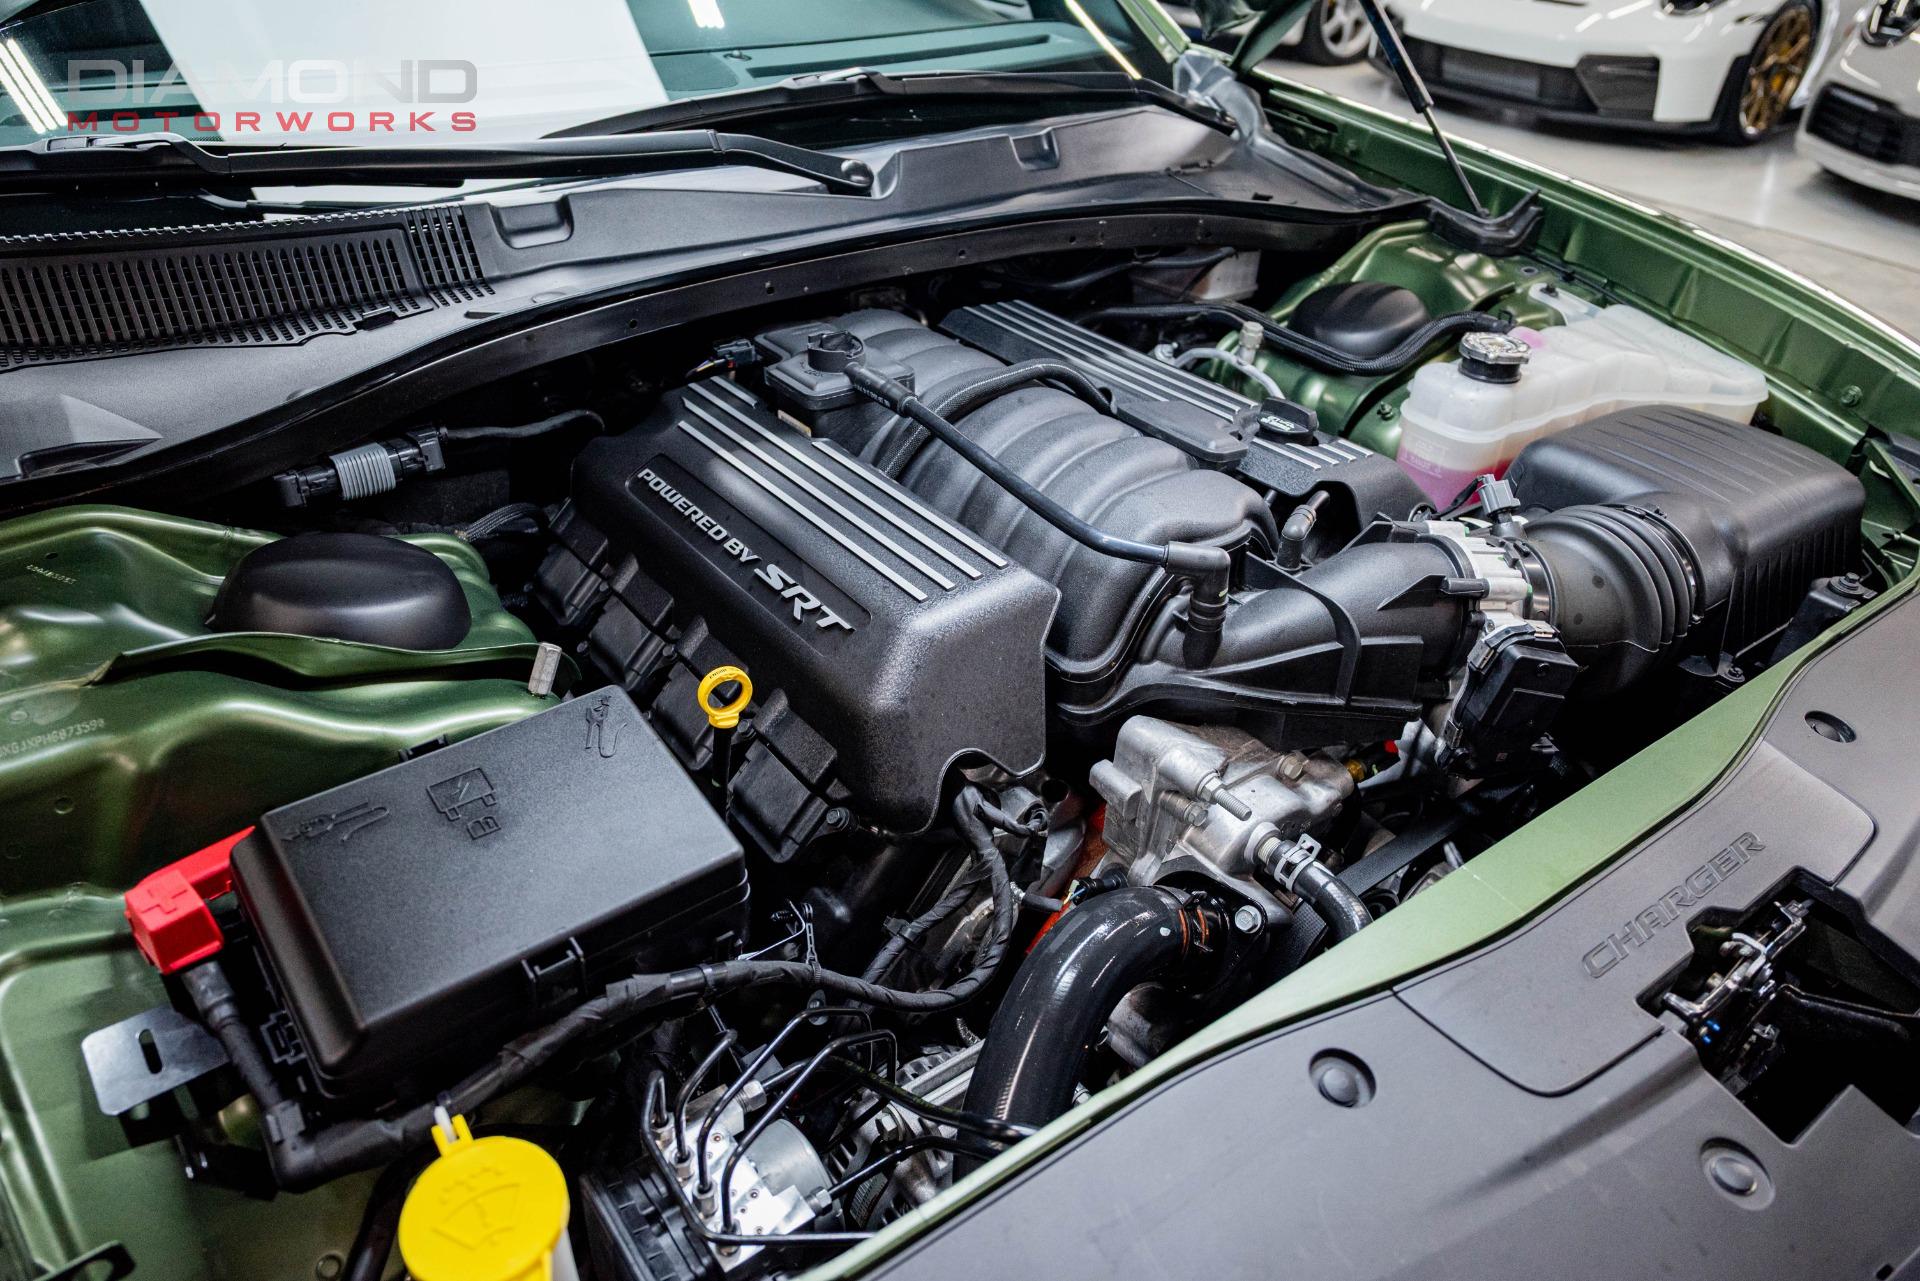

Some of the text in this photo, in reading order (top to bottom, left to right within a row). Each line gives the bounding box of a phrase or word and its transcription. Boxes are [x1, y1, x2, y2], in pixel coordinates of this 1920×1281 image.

[636, 467, 857, 631] POWERED BY SRT
[1581, 831, 1767, 979] CHARGER
